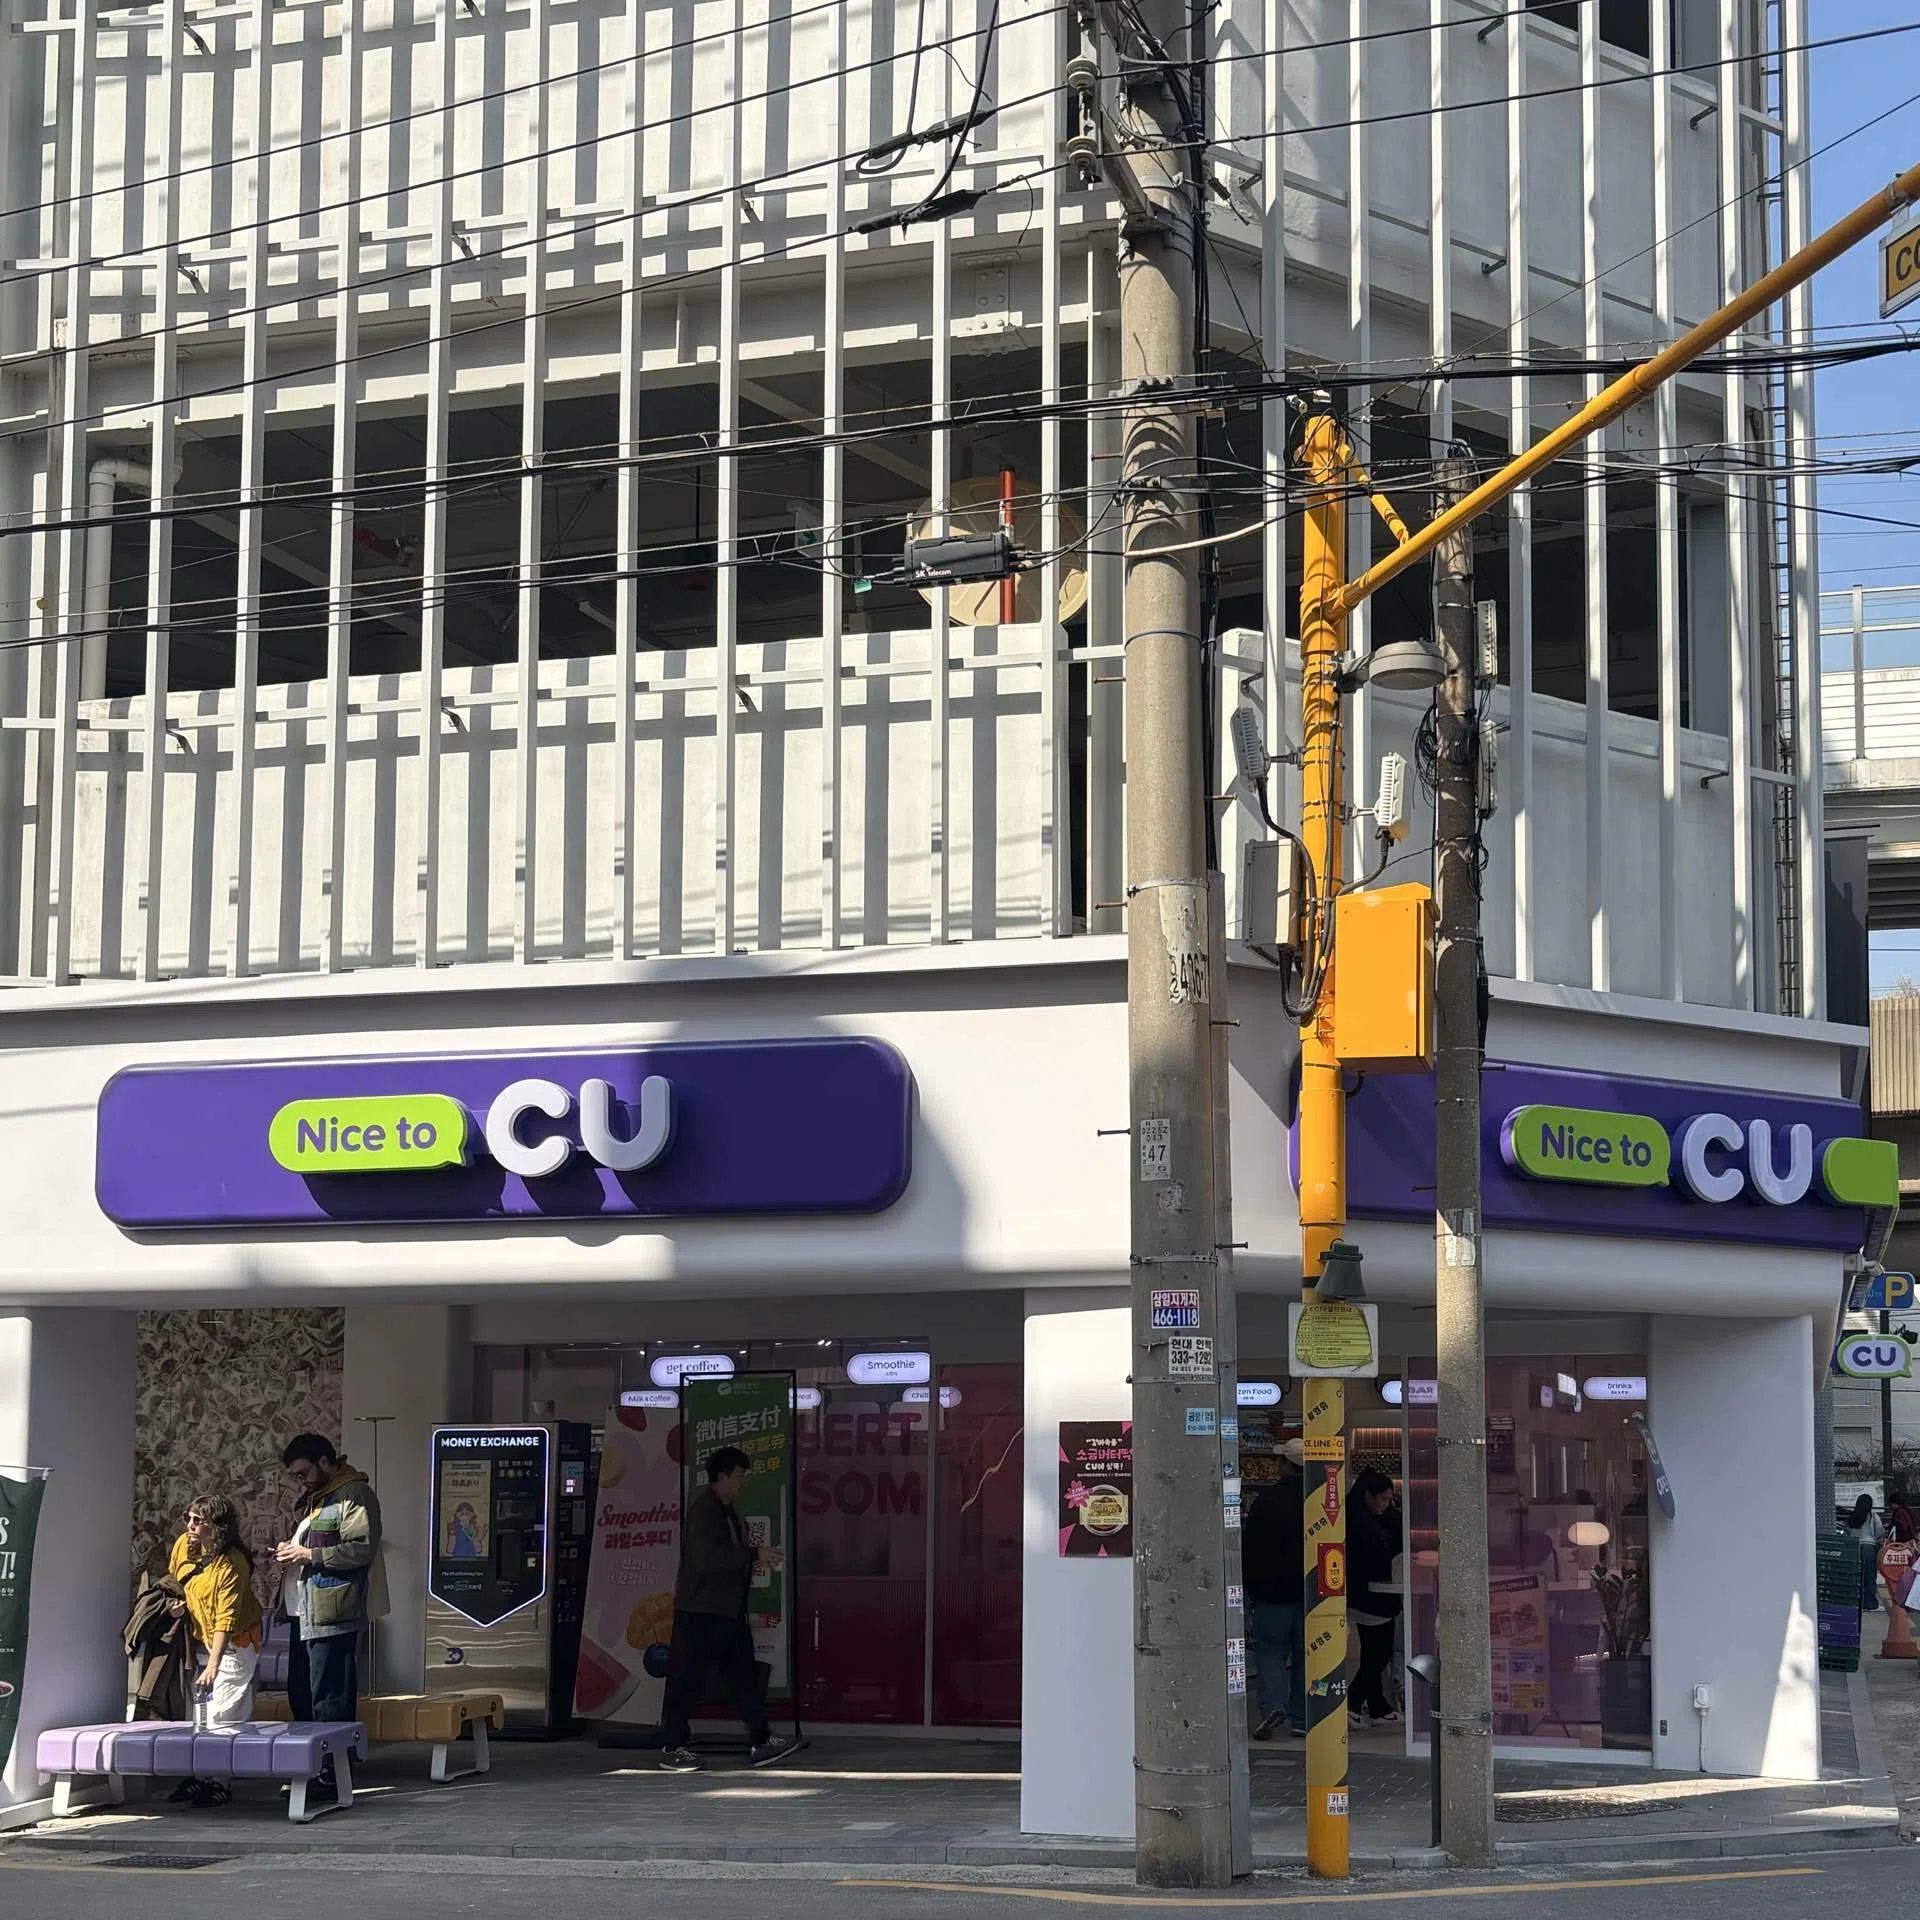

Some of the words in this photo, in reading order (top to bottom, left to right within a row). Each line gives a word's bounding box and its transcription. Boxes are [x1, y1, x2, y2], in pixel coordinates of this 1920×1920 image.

[915, 570, 926, 578] SK
[927, 569, 952, 577] telecom
[297, 1117, 386, 1153] Nice
[395, 1117, 437, 1149] to
[486, 1075, 671, 1177] CU
[1148, 1144, 1166, 1161] 47
[1541, 1123, 1611, 1164] Nice
[1620, 1134, 1652, 1168] to
[1682, 1112, 1813, 1206] CU
[1885, 1275, 1908, 1307] P
[1154, 1308, 1198, 1326] 466-1118
[1171, 1351, 1213, 1365] 333-1292
[1852, 1345, 1896, 1367] CU
[666, 1362, 683, 1374] get
[686, 1360, 720, 1372] coffee
[867, 1359, 916, 1370] Smoothie
[650, 1394, 671, 1402] Coffee
[695, 1404, 782, 1444] 微信支付
[441, 1437, 480, 1447] MONEY
[480, 1436, 540, 1447] EXCHANGE
[1313, 1440, 1331, 1448] LINE
